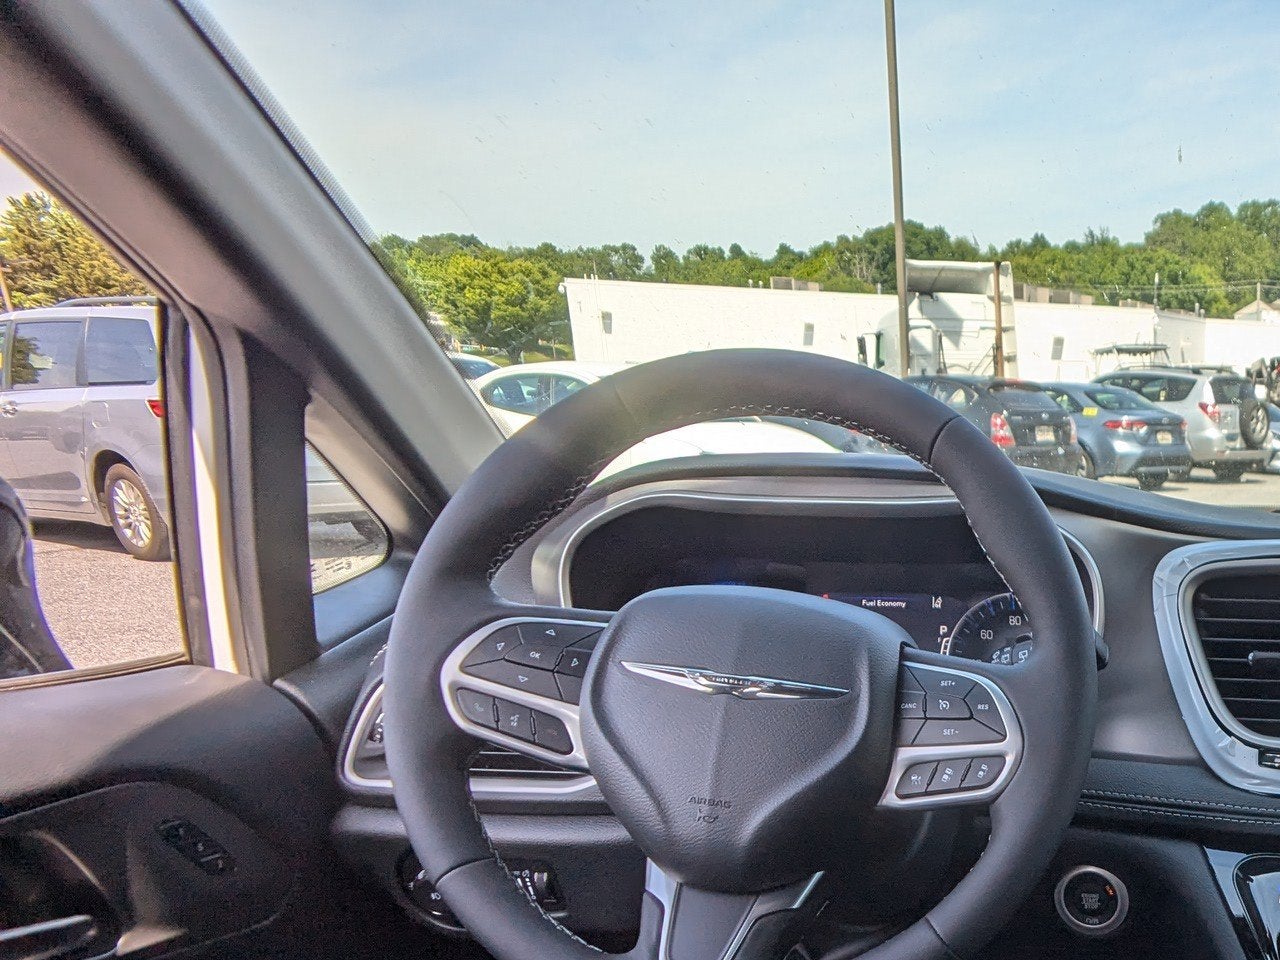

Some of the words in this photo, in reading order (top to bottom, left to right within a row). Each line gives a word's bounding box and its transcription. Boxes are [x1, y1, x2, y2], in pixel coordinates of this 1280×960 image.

[862, 599, 876, 607] Fuel
[877, 600, 906, 608] Economy
[1008, 615, 1022, 626] 80
[939, 625, 948, 635] P
[980, 629, 993, 640] 60
[529, 651, 541, 659] OK
[688, 796, 733, 809] AIRBAG
